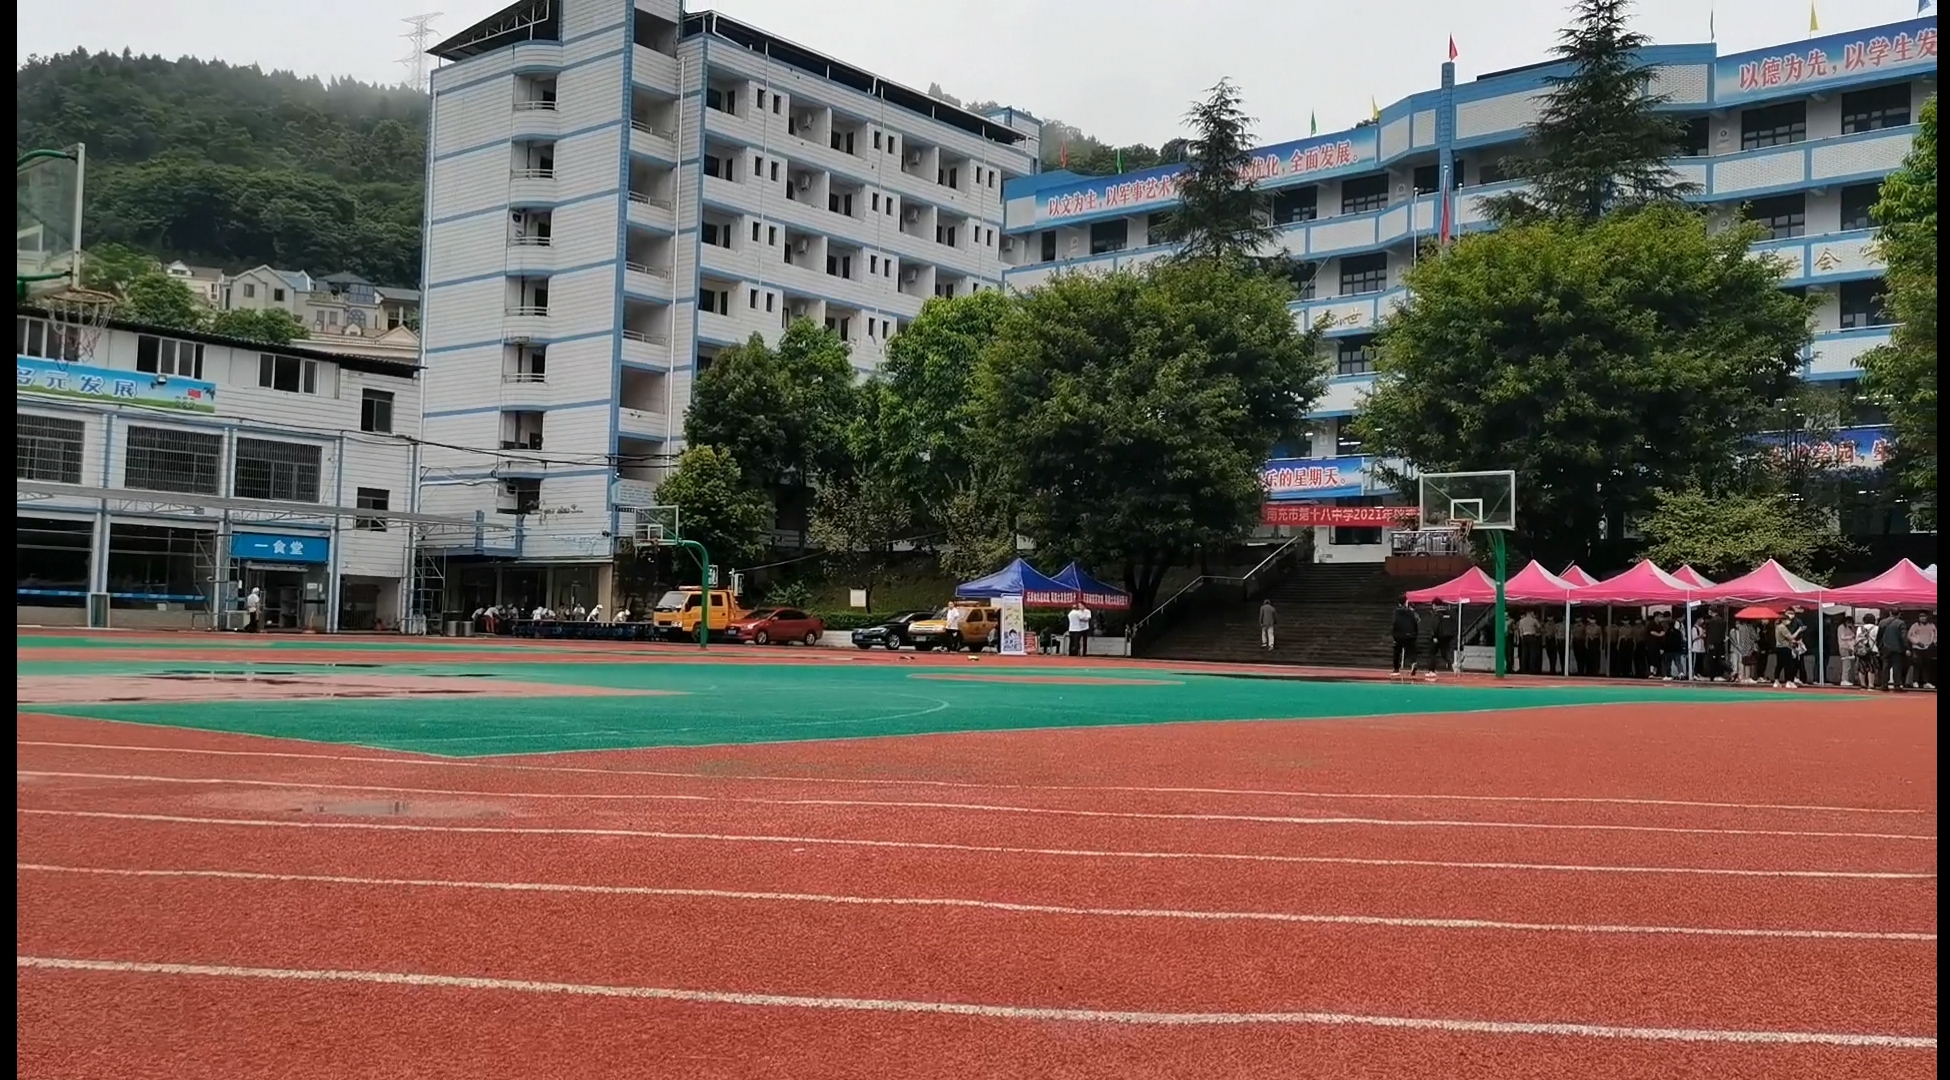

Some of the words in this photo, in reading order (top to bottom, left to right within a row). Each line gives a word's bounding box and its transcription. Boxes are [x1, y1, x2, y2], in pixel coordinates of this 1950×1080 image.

[1049, 174, 1180, 217] 以文为主，以军事艺术
[17, 365, 137, 398] 多元发展
[254, 540, 304, 555] 一食堂
